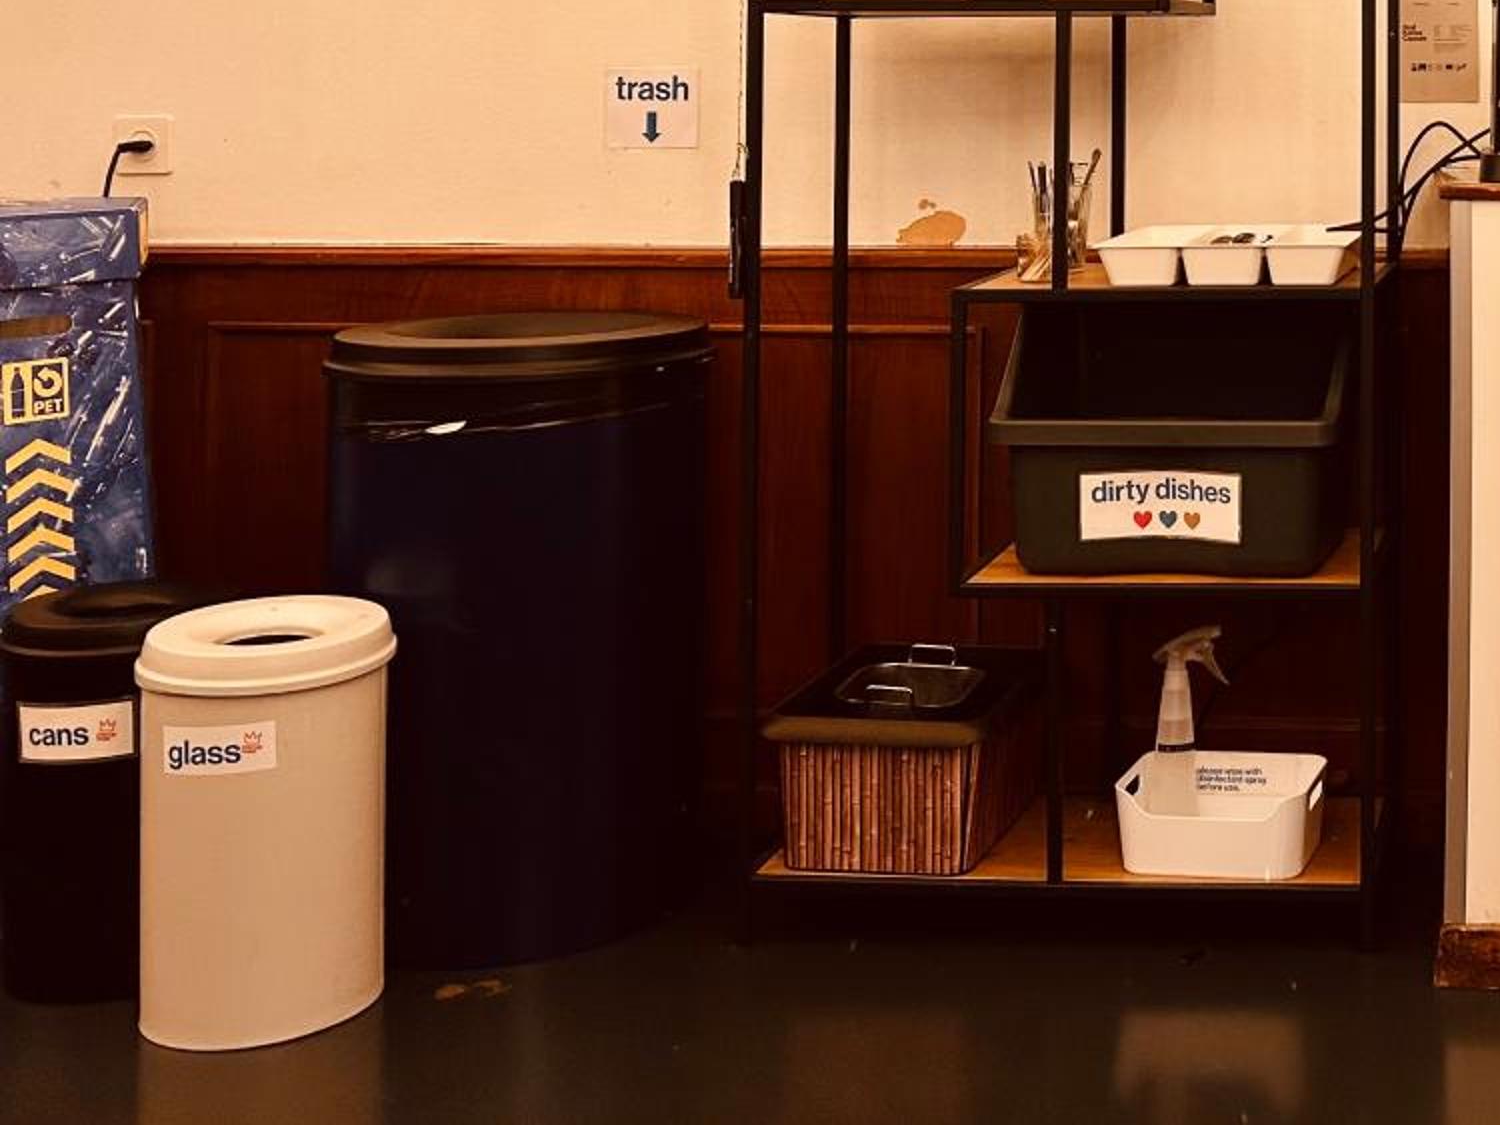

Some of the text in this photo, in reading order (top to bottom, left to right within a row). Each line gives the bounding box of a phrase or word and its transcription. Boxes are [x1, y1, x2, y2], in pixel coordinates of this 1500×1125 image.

[615, 75, 689, 101] trash
[33, 398, 63, 414] PET
[1091, 478, 1231, 504] dirty dishes
[29, 726, 90, 746] cans
[168, 740, 241, 769] glass
